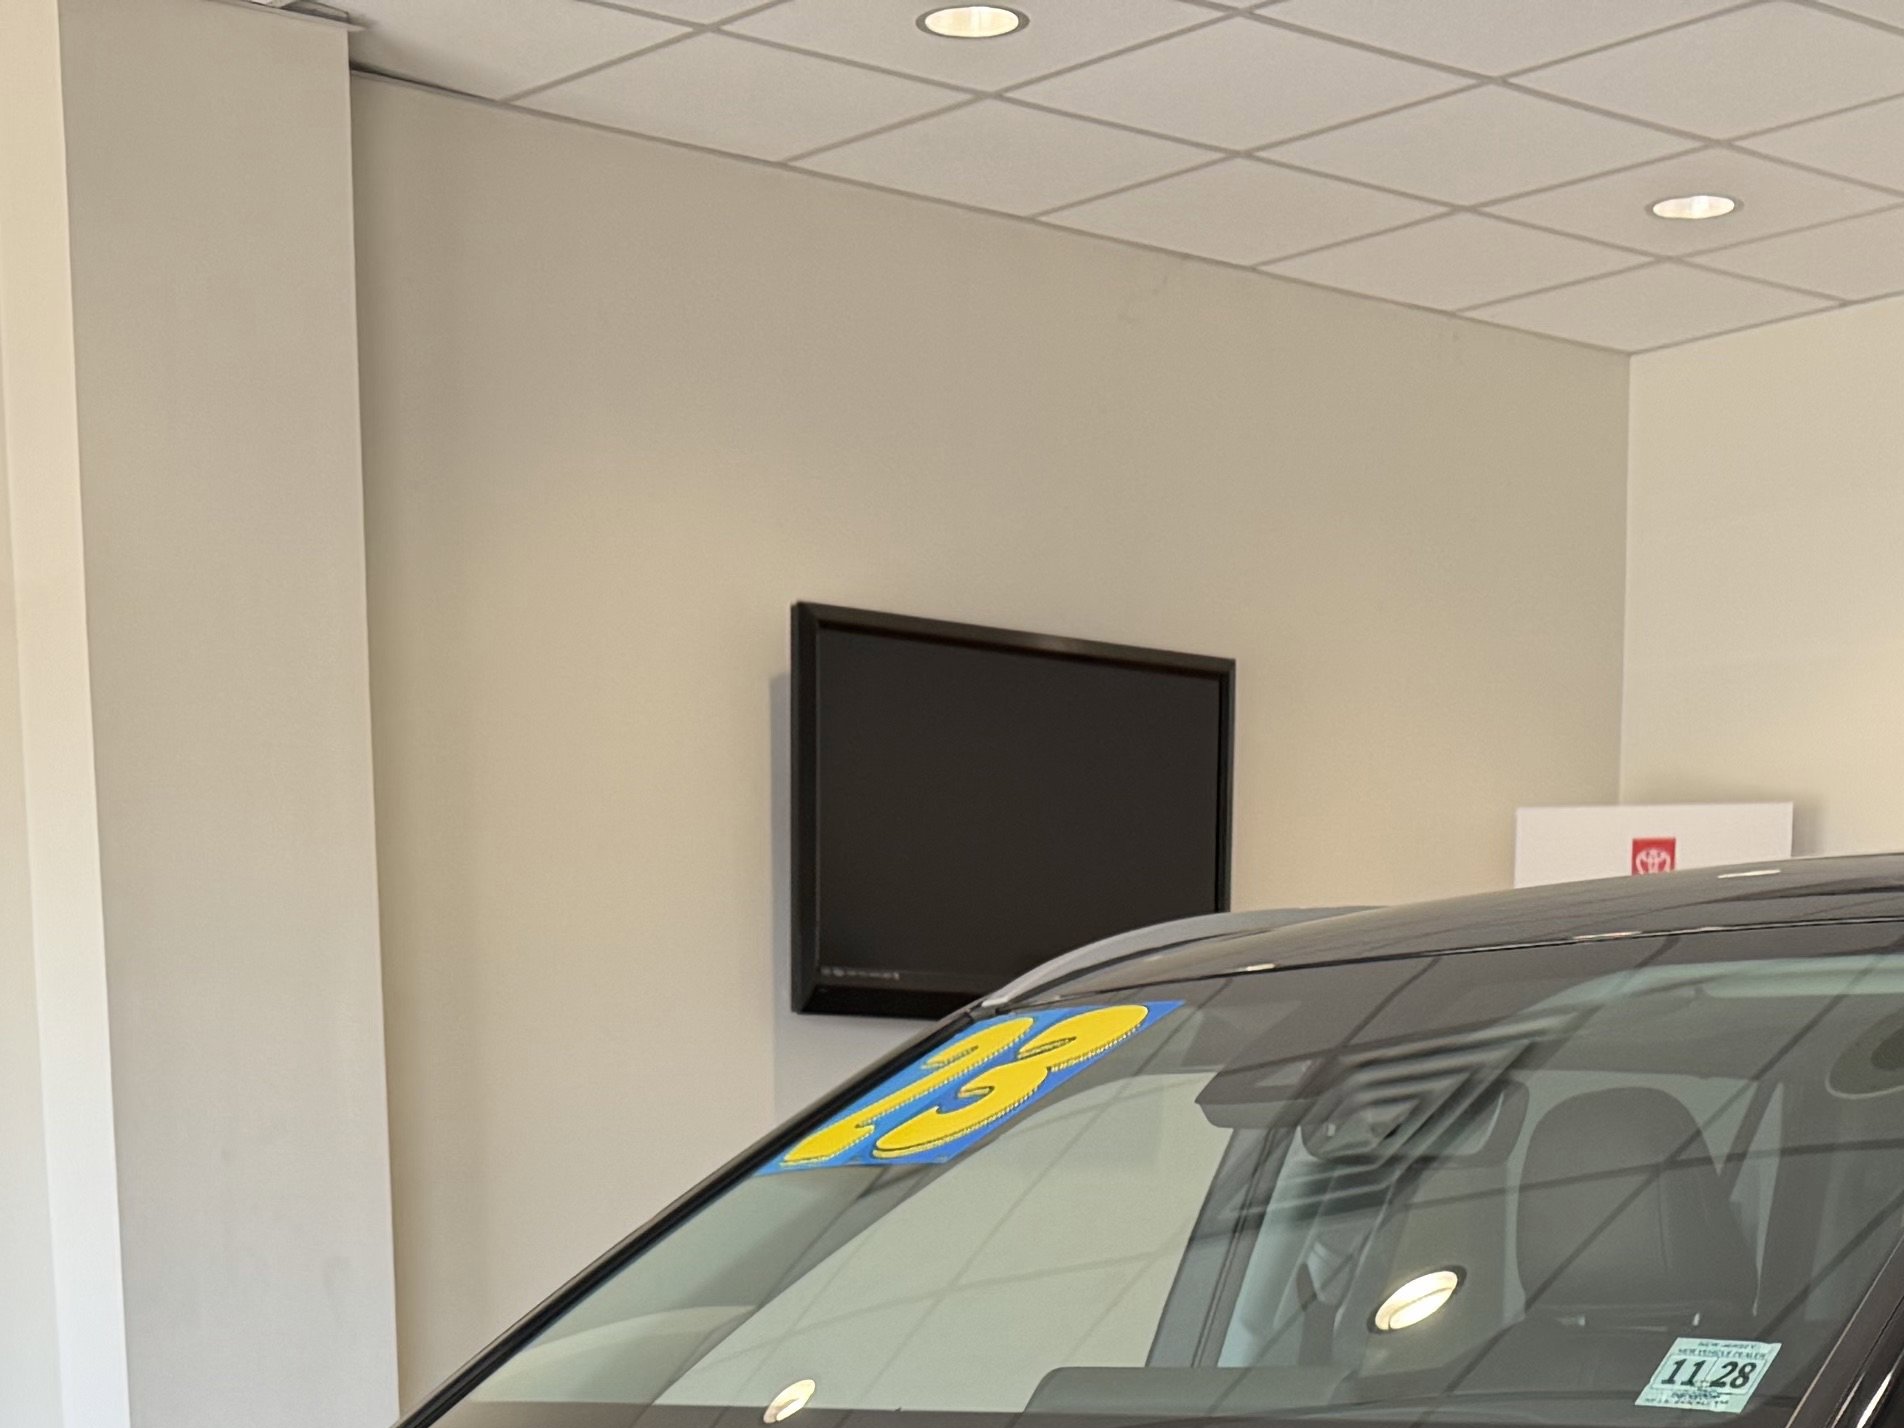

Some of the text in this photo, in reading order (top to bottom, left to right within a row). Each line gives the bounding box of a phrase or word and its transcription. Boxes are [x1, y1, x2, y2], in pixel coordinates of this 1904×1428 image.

[779, 1004, 1150, 1161] 23
[1661, 1358, 1757, 1389] 11 28
